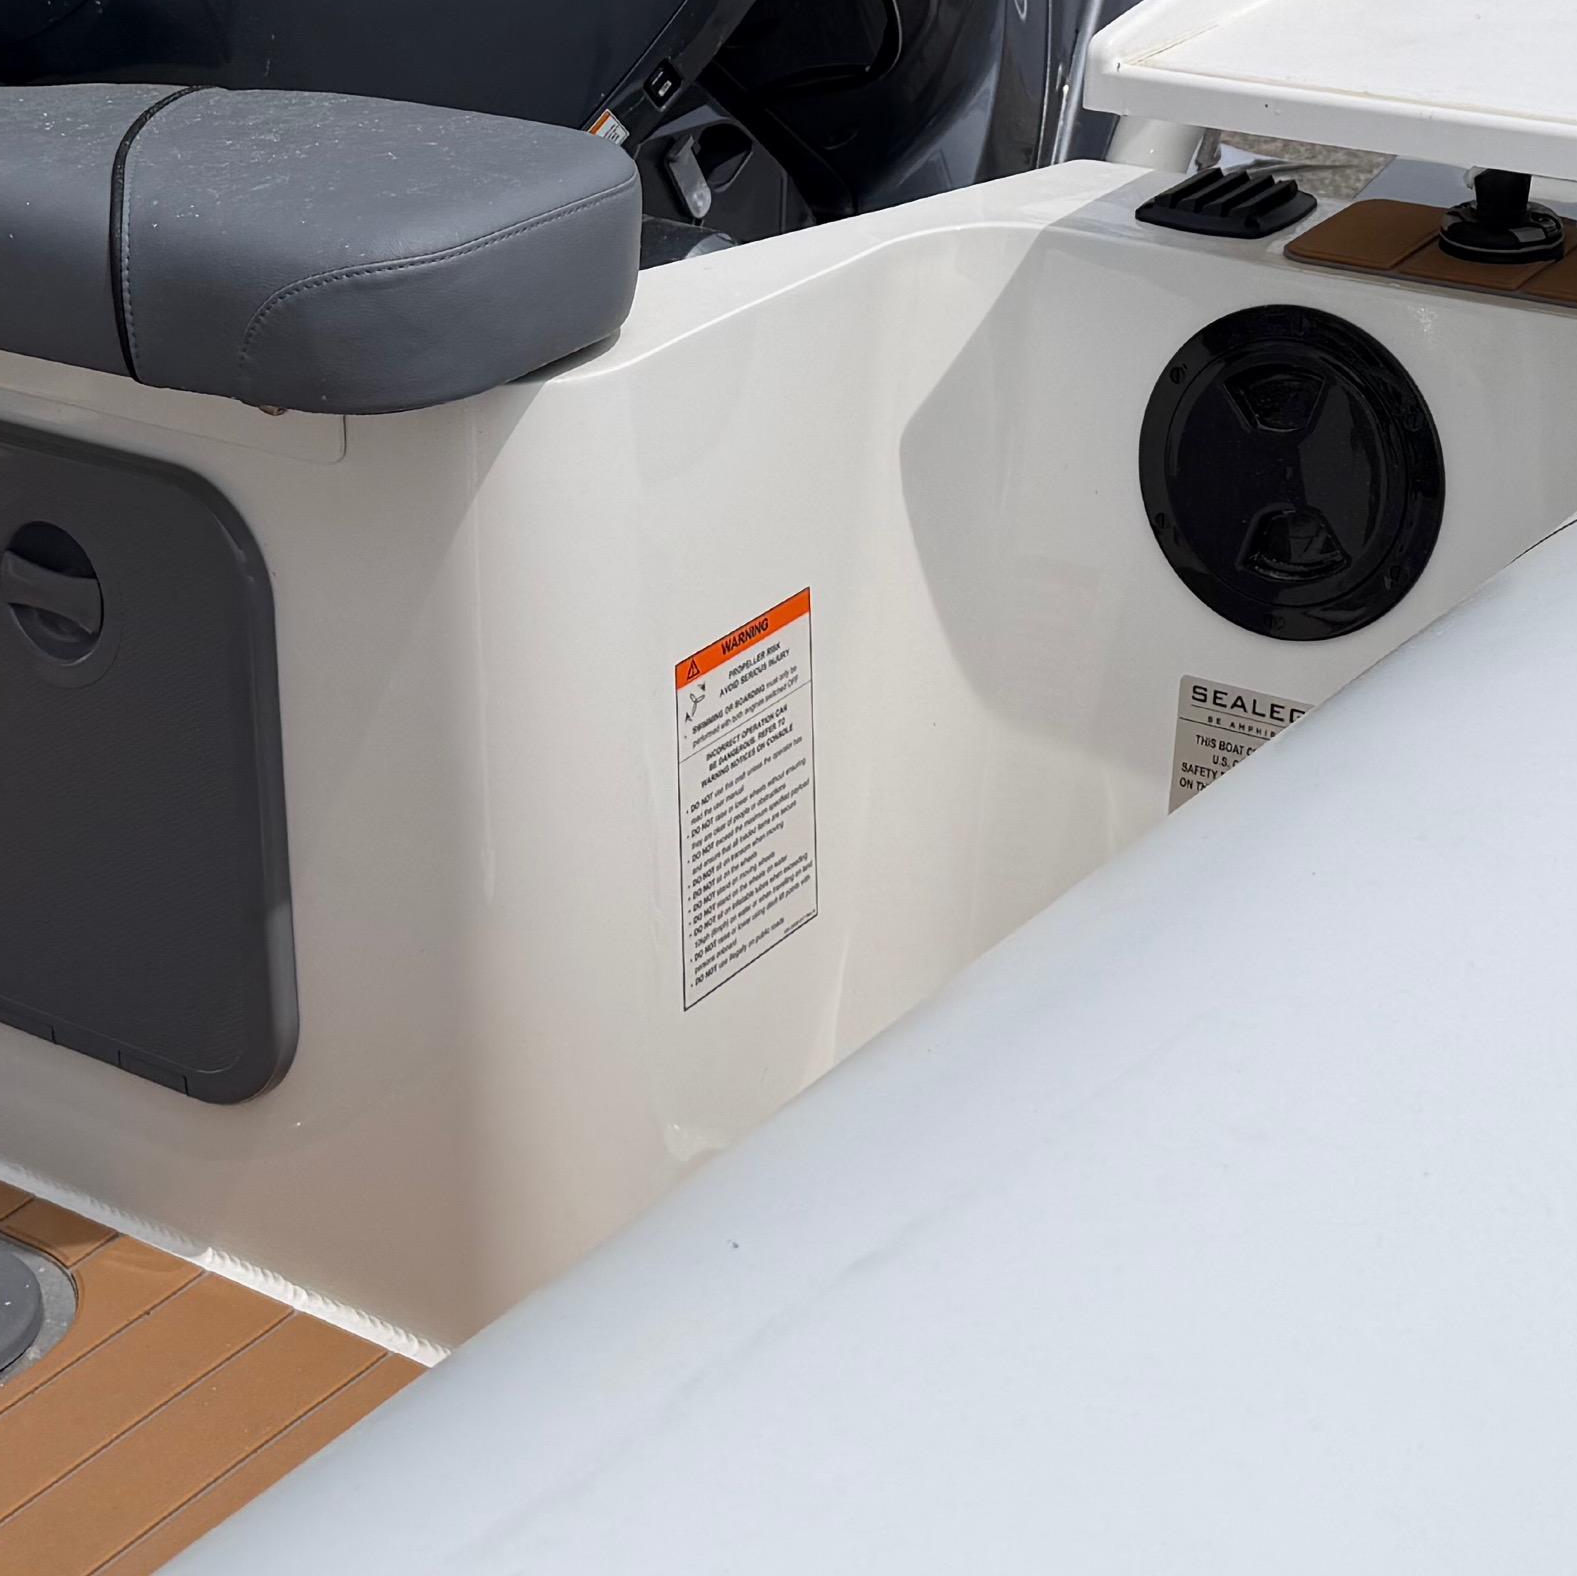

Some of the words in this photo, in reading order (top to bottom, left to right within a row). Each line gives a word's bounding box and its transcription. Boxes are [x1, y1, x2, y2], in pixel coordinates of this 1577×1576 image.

[721, 615, 768, 657] WARNING
[728, 649, 765, 680] PROPELLER
[719, 677, 739, 698] AVOID
[740, 660, 766, 685] SERIOUS
[1207, 715, 1222, 725] BE
[1195, 734, 1216, 749] THIS
[1218, 740, 1244, 755] BOAT
[1181, 762, 1218, 778] SAFETY
[1179, 777, 1193, 789] ON
